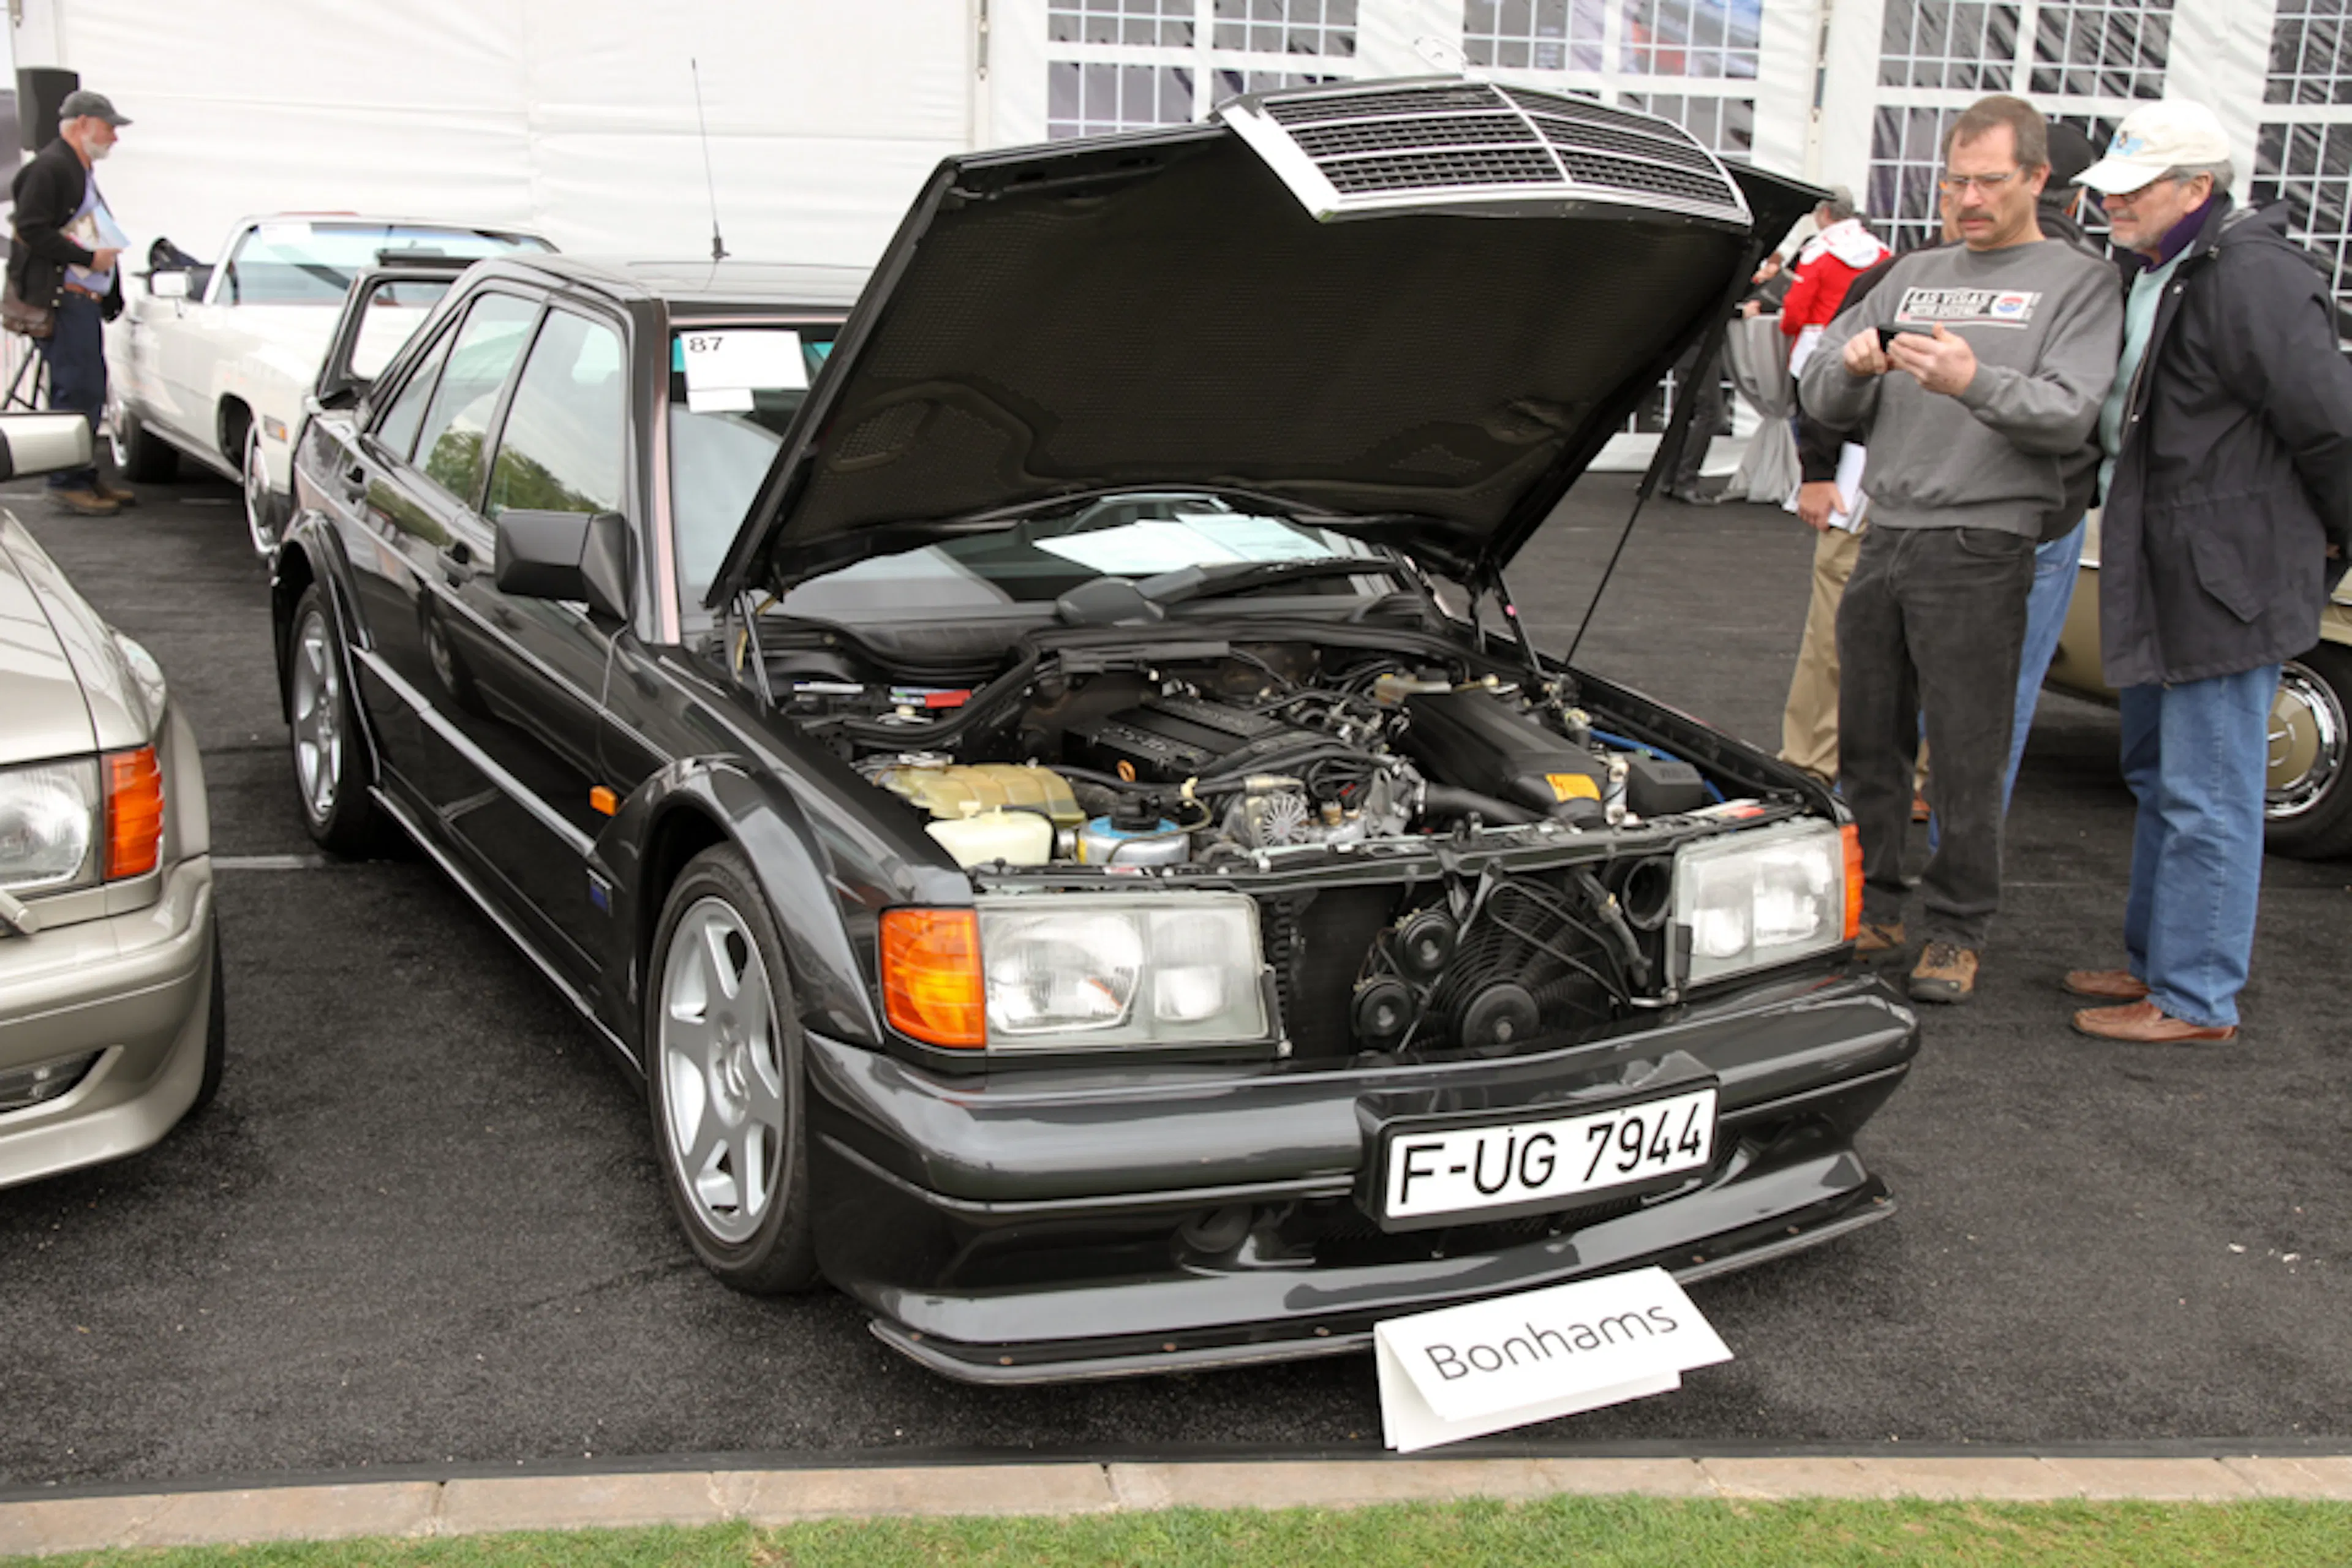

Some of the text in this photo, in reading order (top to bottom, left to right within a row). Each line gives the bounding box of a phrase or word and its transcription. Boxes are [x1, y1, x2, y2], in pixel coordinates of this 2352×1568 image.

[689, 336, 724, 352] 87
[1400, 1102, 1702, 1204] F-UG 7944
[1425, 1306, 1678, 1380] Bonhams
